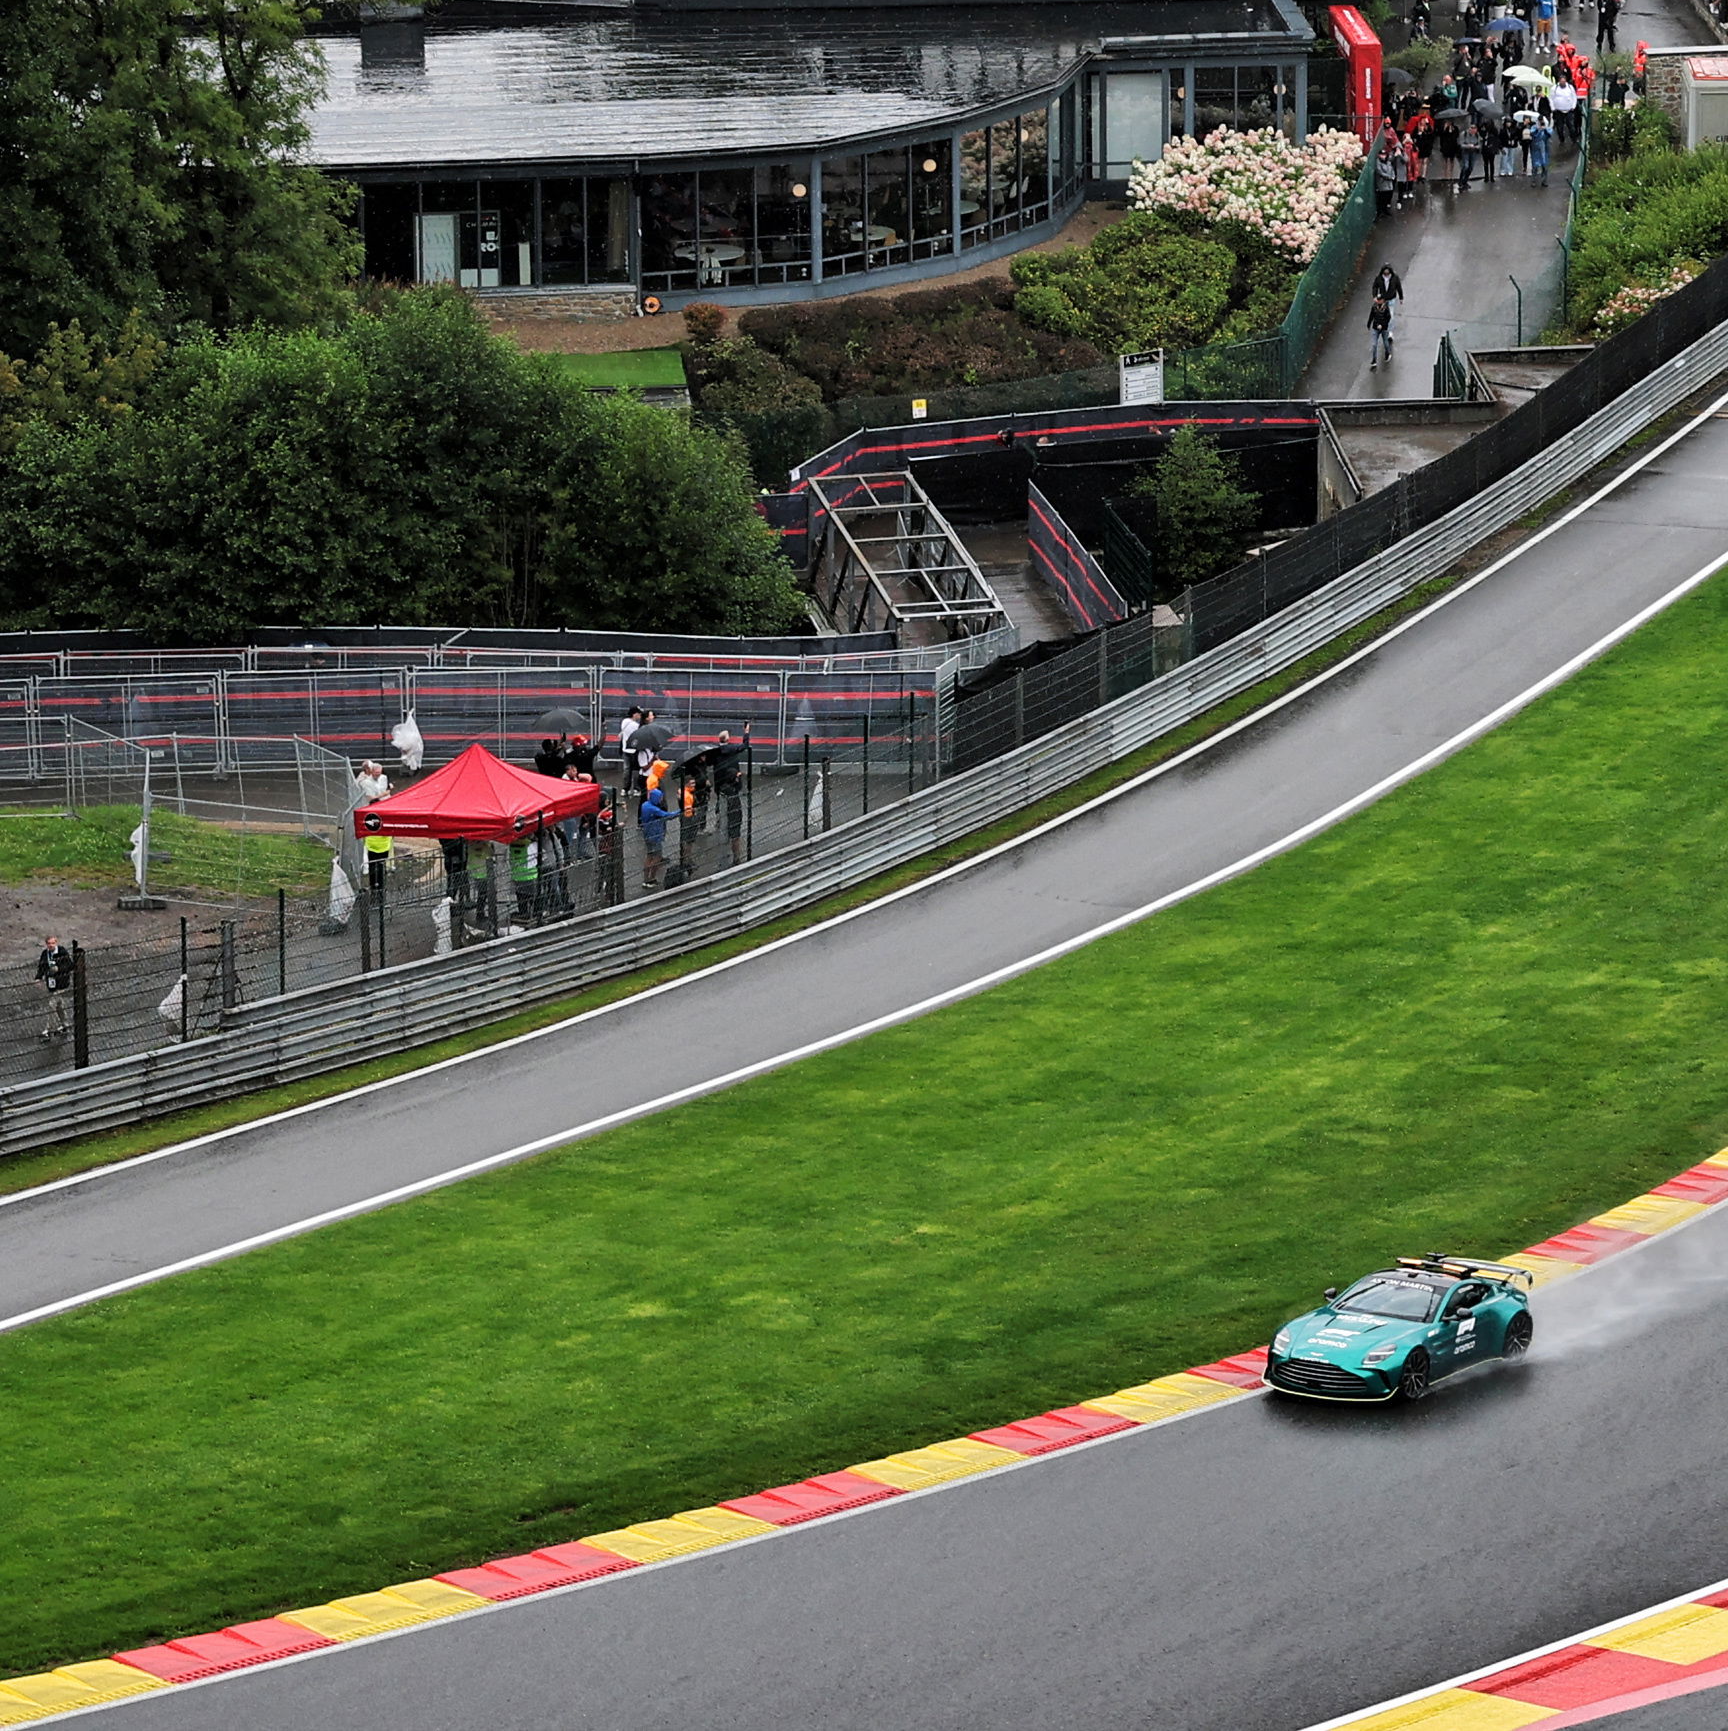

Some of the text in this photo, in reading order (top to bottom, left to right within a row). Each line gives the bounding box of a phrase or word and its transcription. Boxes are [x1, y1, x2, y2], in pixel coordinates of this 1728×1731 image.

[1370, 1277, 1434, 1293] ASTON MARTIN
[1307, 1338, 1347, 1349] aramco
[1453, 1341, 1476, 1355] aramco
